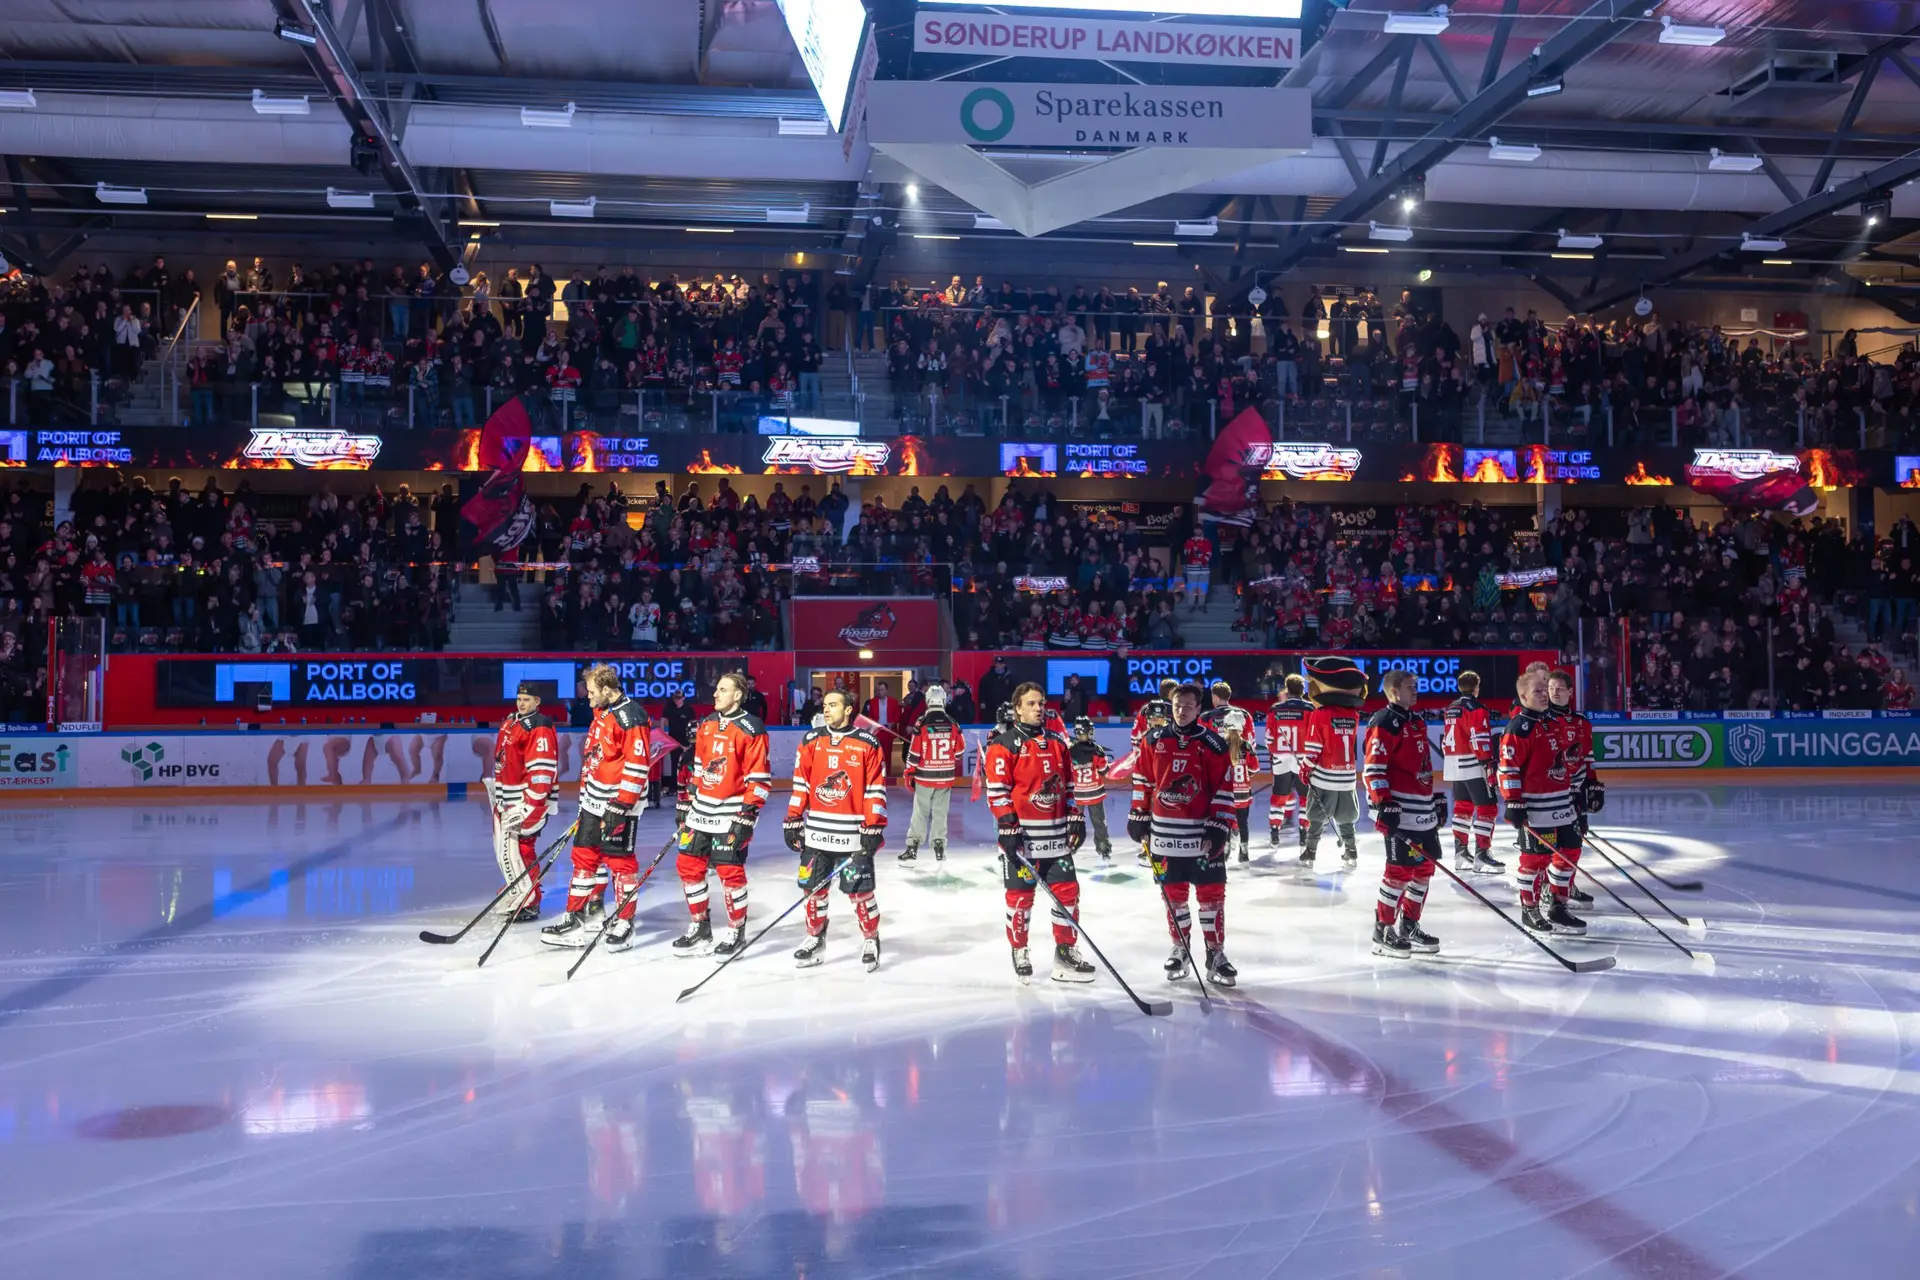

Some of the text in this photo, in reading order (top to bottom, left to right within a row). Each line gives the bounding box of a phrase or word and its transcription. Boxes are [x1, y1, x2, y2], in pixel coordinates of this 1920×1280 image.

[923, 20, 1294, 60] SØNDERUP LANDKØKKEN
[1035, 90, 1224, 119] Sparekassen
[1075, 129, 1190, 144] DANMARK
[37, 432, 120, 444] PORT OF
[572, 438, 649, 451] PRT OF
[37, 448, 131, 461] AALBORG
[1066, 445, 1137, 456] PORT OF
[1525, 452, 1591, 464] PRT OF
[571, 454, 659, 467] ALBORG
[1066, 460, 1147, 472] AALBORG
[1525, 467, 1600, 479] ALBORG
[838, 617, 889, 638] Pirates
[307, 663, 402, 680] PORT OF
[591, 663, 683, 678] ORT OF
[1127, 660, 1212, 675] PORT OF
[1378, 659, 1460, 674] PORT OF
[306, 683, 416, 700] AALBORG
[622, 682, 696, 698] LBORG
[535, 737, 549, 752] 31
[1277, 726, 1298, 752] 21
[1603, 734, 1694, 759] SKILTE
[712, 740, 725, 755] 14
[931, 739, 950, 760] 12
[1371, 738, 1388, 756] 24
[828, 755, 839, 769] 18
[995, 758, 1006, 775] 2
[1043, 760, 1051, 773] 2
[1172, 759, 1187, 773] 87
[158, 764, 220, 778] HP BYG
[1076, 768, 1093, 783] 12
[1234, 765, 1244, 783] 8
[1552, 809, 1574, 820] Cool
[811, 832, 850, 845] CoolEast
[1028, 841, 1066, 851] CoolEa
[1154, 838, 1199, 849] CoolEast
